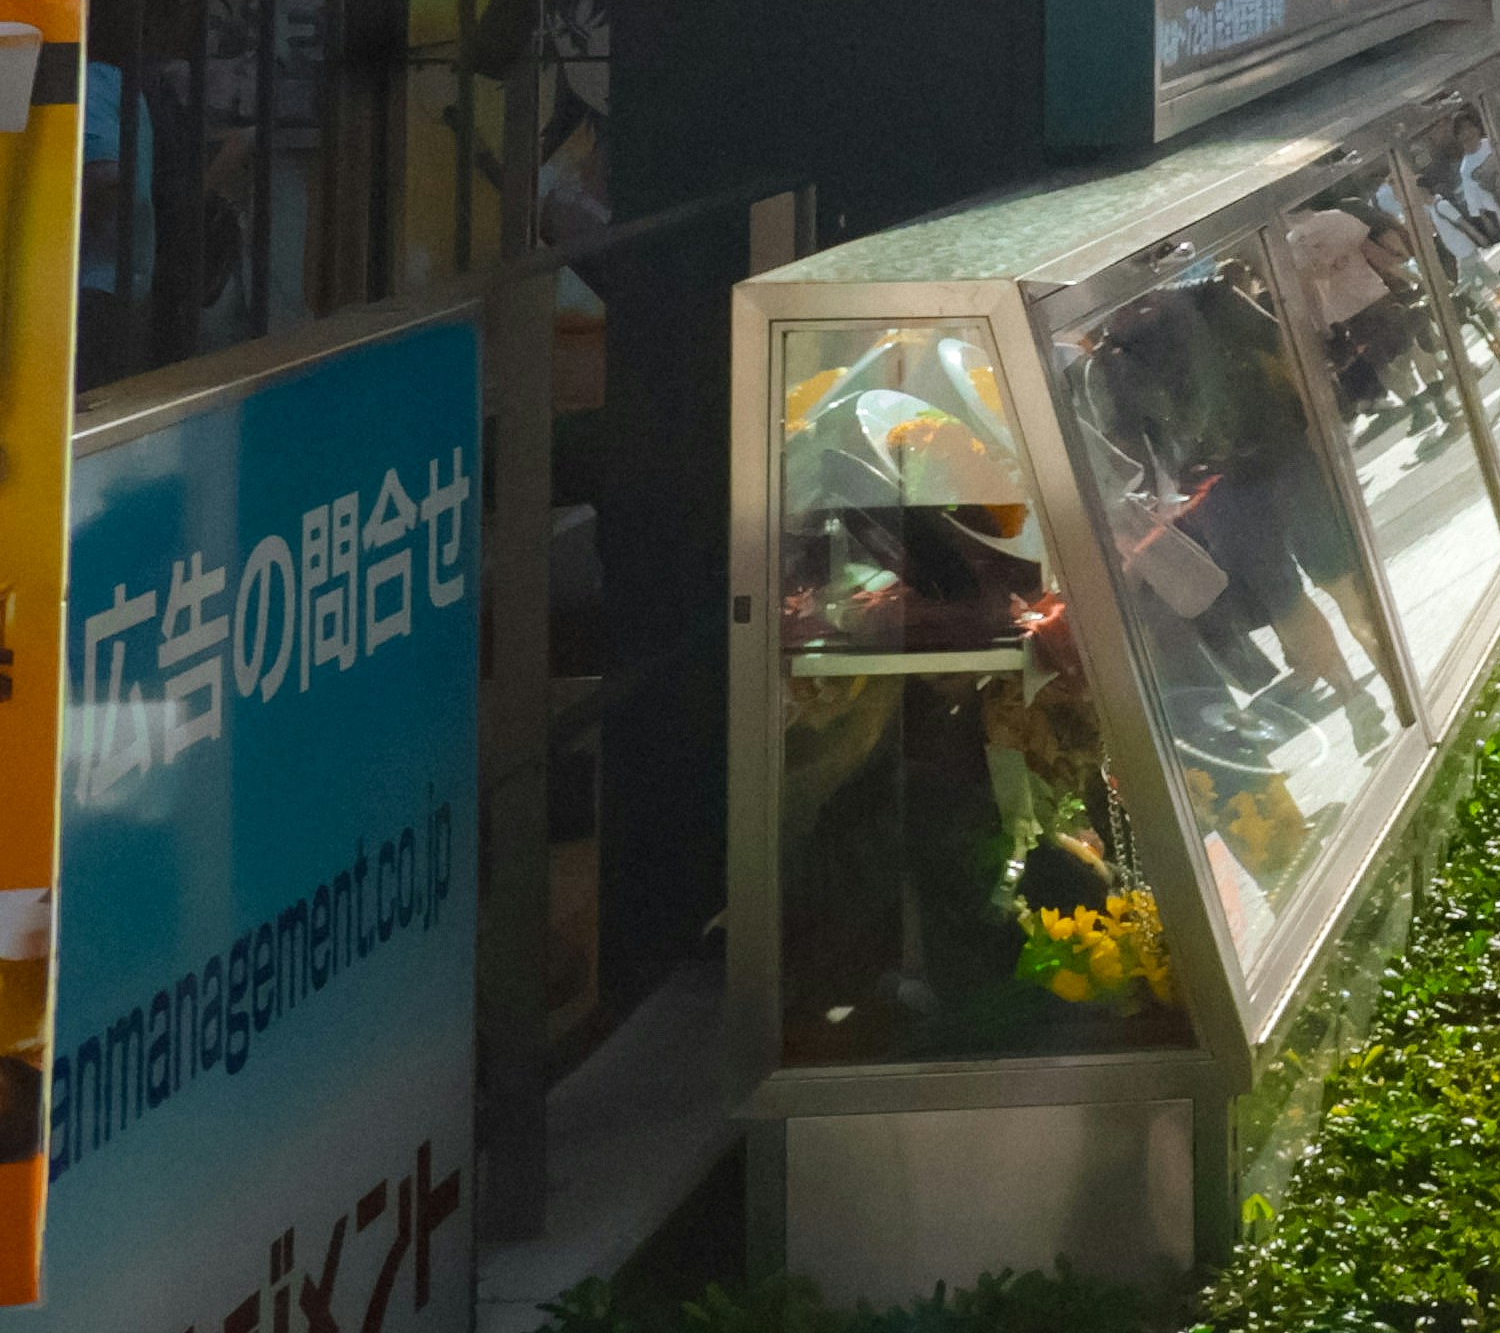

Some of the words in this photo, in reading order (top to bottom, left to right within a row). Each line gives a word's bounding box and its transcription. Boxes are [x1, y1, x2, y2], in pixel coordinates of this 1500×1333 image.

[75, 446, 469, 808] 広告の問合せ
